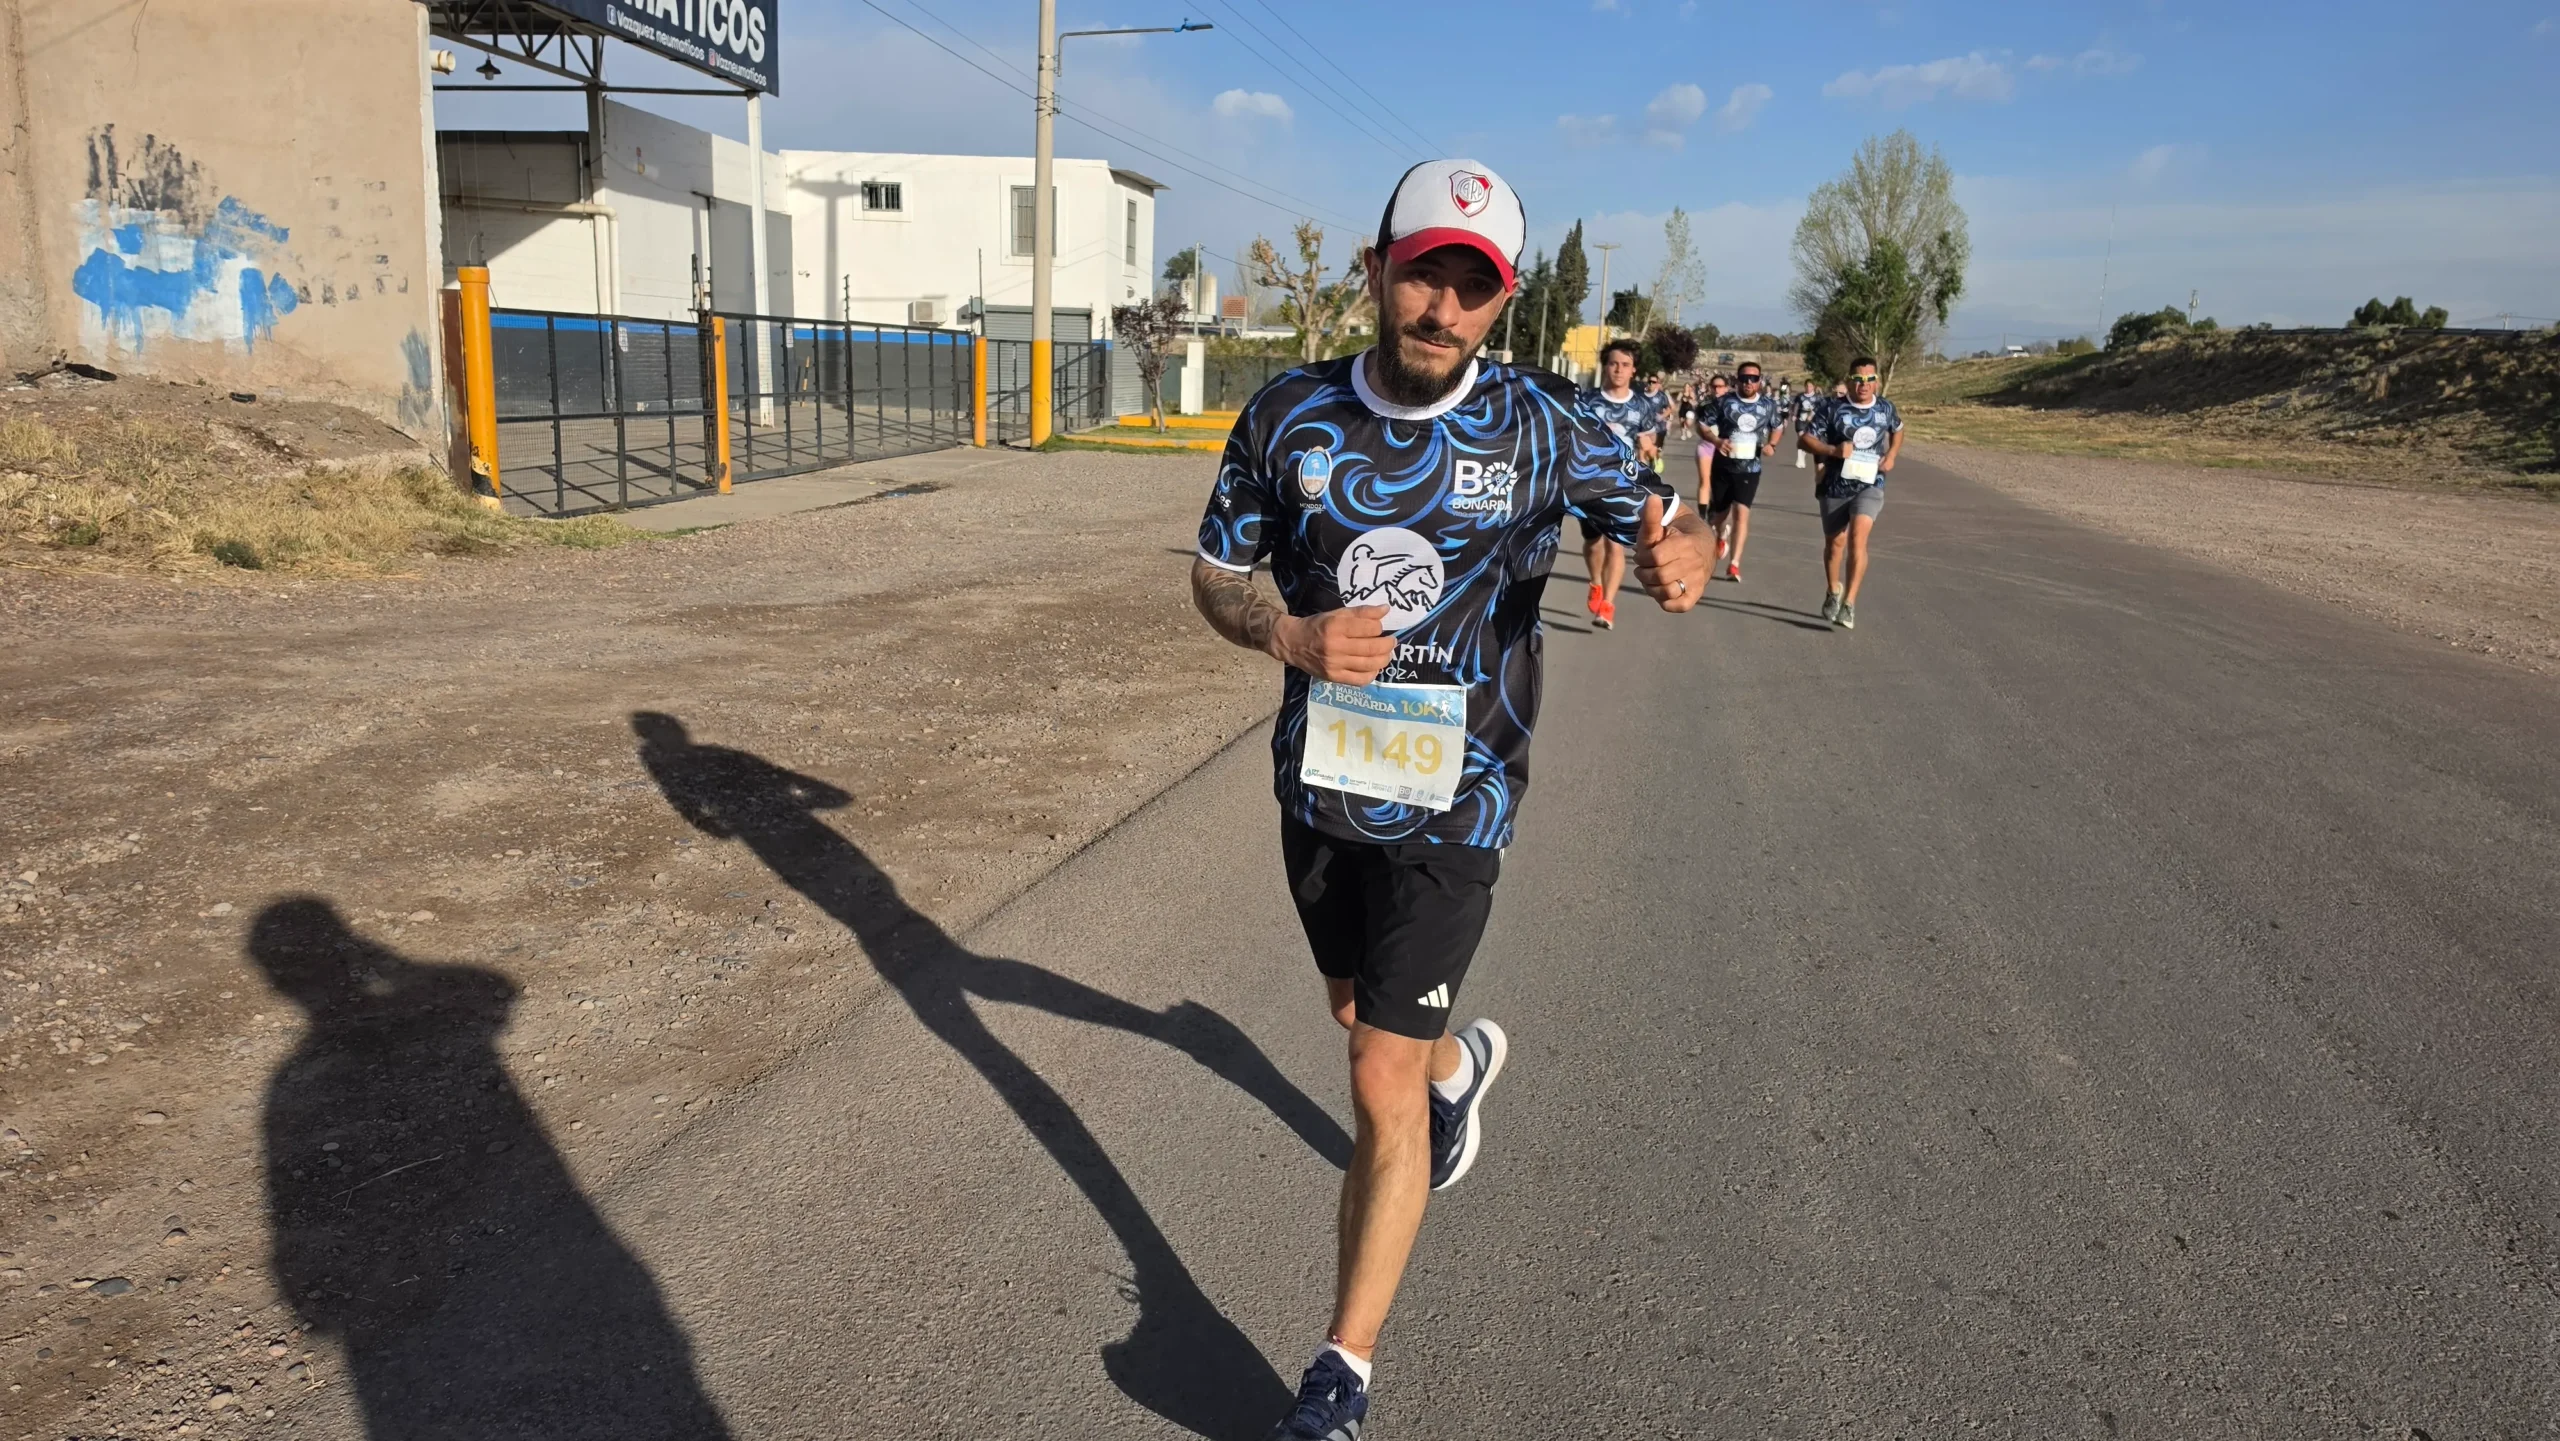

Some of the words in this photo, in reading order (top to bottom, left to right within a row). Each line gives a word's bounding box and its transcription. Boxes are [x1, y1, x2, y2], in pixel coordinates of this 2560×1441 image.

[617, 10, 655, 40] Vazquez
[656, 29, 705, 61] neumaticos
[715, 51, 767, 87] Vazneumaticos
[1300, 502, 1327, 510] MENDOZA
[1452, 498, 1513, 511] BONARDA
[1390, 641, 1455, 664] RTÍN
[1335, 685, 1372, 700] MARATÓN
[1335, 692, 1397, 713] BONARDA
[1401, 700, 1438, 718] 10K
[1328, 718, 1443, 775] 1149
